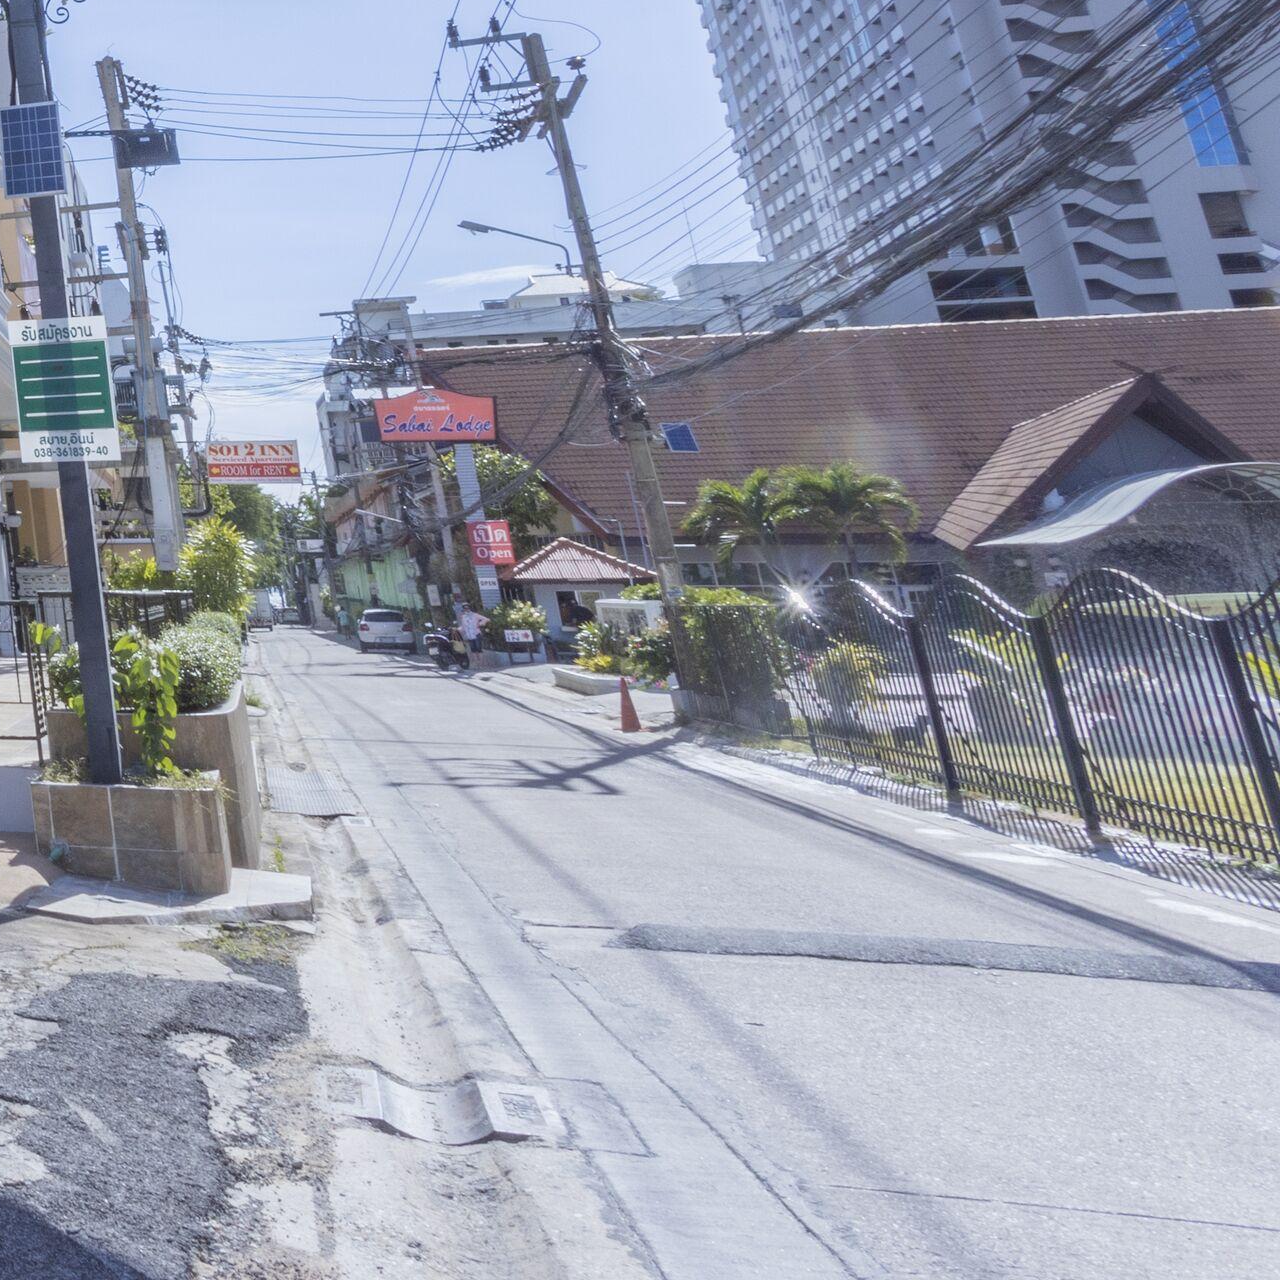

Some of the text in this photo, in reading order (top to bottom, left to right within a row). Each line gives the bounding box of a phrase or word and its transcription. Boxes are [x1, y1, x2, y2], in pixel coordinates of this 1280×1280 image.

[383, 413, 492, 438] Sabai Lodge
[34, 446, 109, 458] 038-361839-40
[208, 442, 294, 456] SOI 2 INN
[221, 465, 287, 476] ROOM for RENT
[473, 524, 508, 543] เปิด
[476, 547, 512, 561] Open
